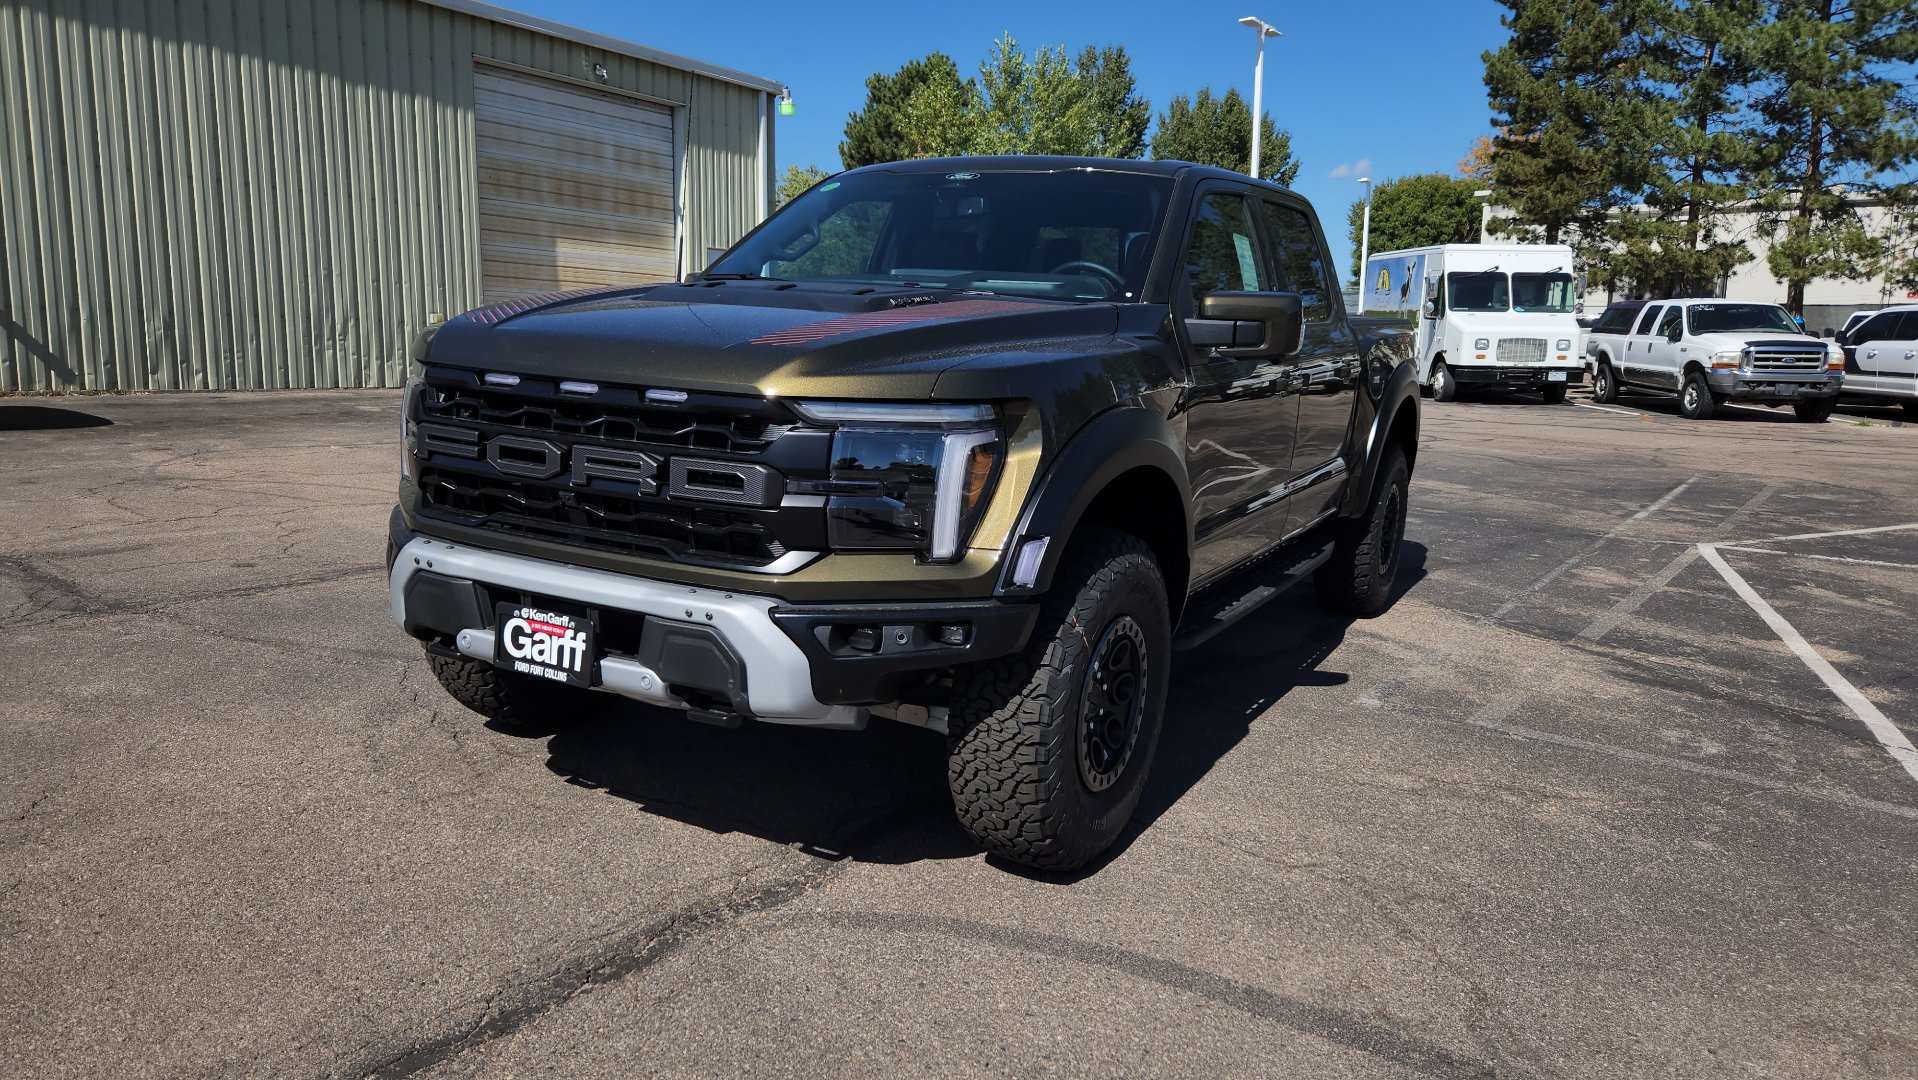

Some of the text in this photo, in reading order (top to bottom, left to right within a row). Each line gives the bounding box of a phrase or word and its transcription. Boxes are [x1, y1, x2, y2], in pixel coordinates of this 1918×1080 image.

[415, 422, 782, 507] FORD
[529, 608, 569, 628] Ken Garff
[503, 618, 587, 672] Garff
[514, 660, 568, 682] FORD FORT COLLINS
